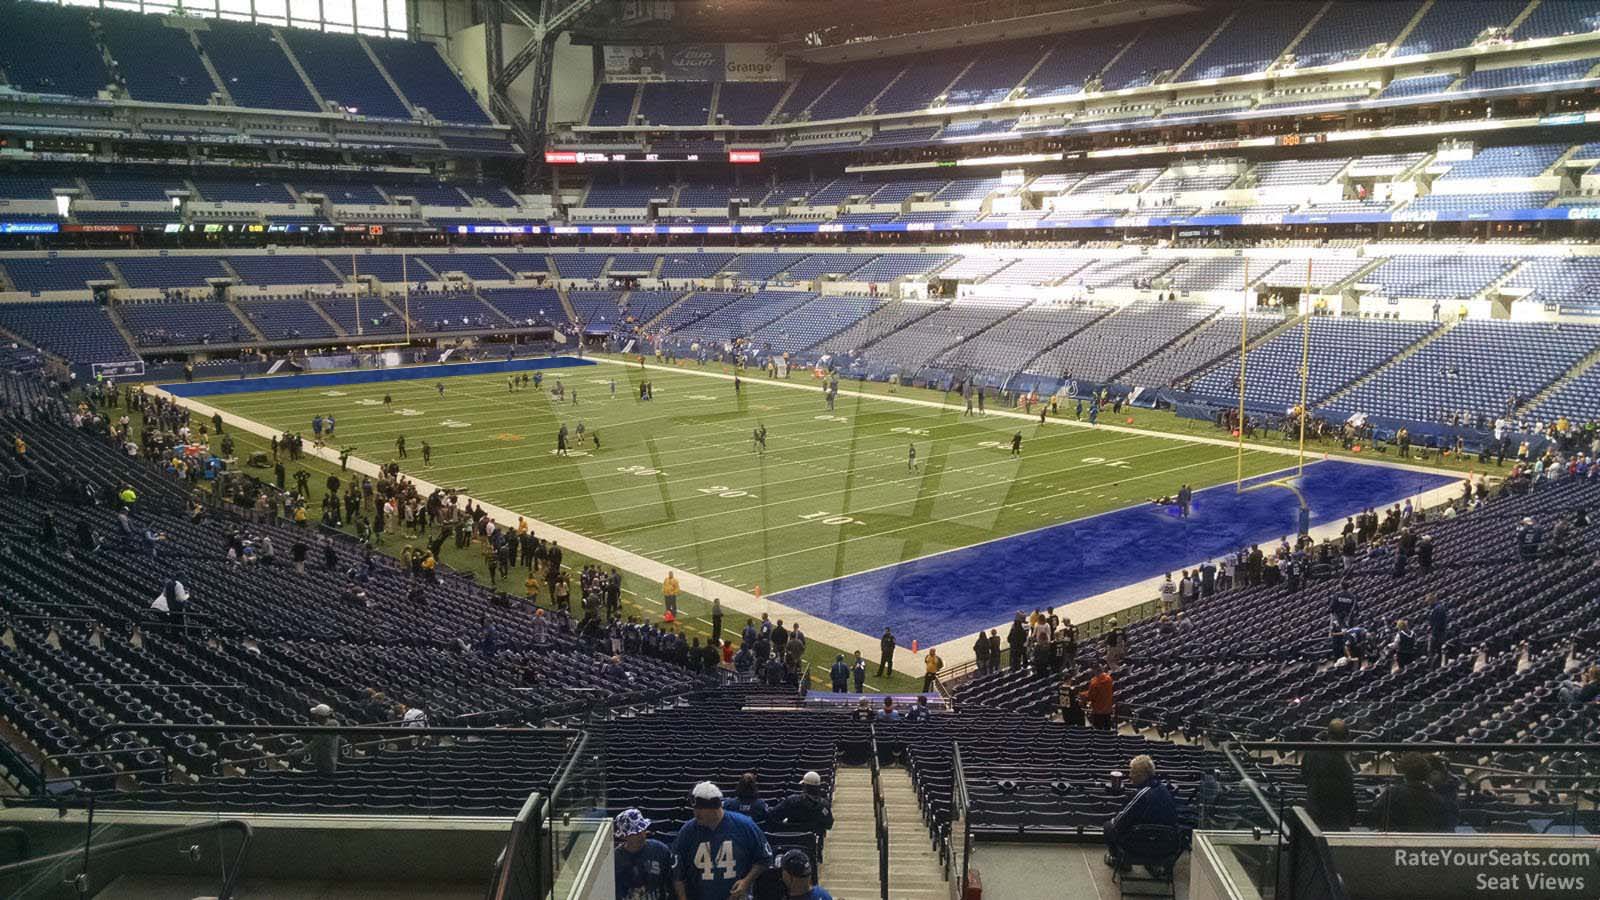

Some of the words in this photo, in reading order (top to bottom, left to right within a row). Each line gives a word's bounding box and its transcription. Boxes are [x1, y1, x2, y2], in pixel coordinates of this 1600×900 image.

[727, 61, 772, 74] Grange
[697, 486, 748, 498] 20
[798, 511, 854, 525] 10
[694, 840, 737, 880] 44
